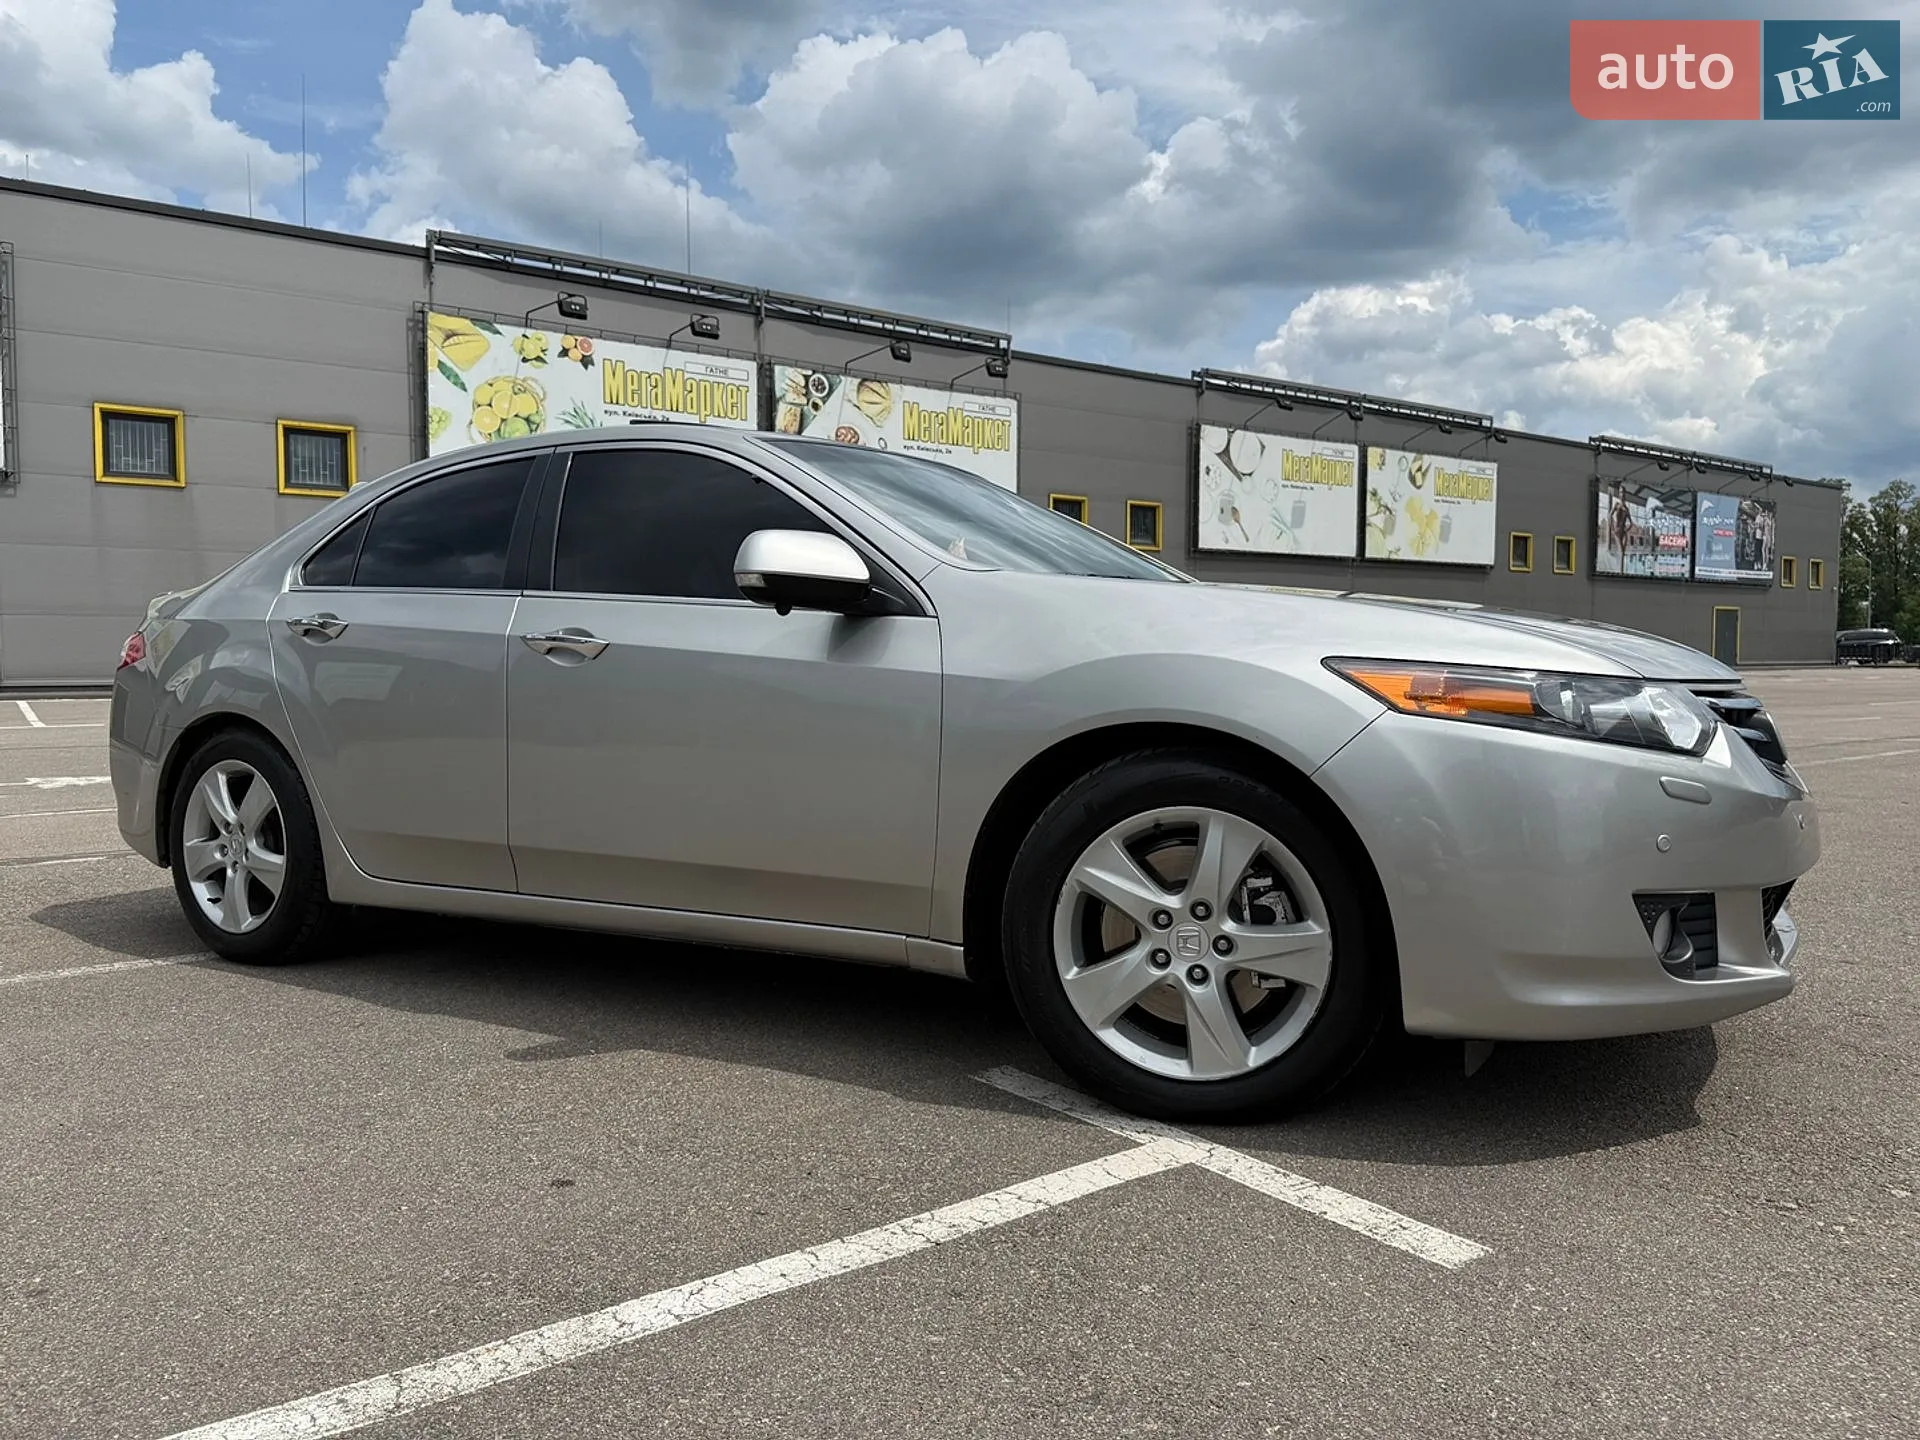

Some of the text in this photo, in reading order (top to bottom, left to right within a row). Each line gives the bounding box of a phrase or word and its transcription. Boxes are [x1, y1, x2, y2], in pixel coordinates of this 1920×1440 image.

[603, 358, 749, 423] МегаМаркет
[903, 400, 1011, 454] МегаМаркет
[1282, 448, 1355, 490] МегаМаркет
